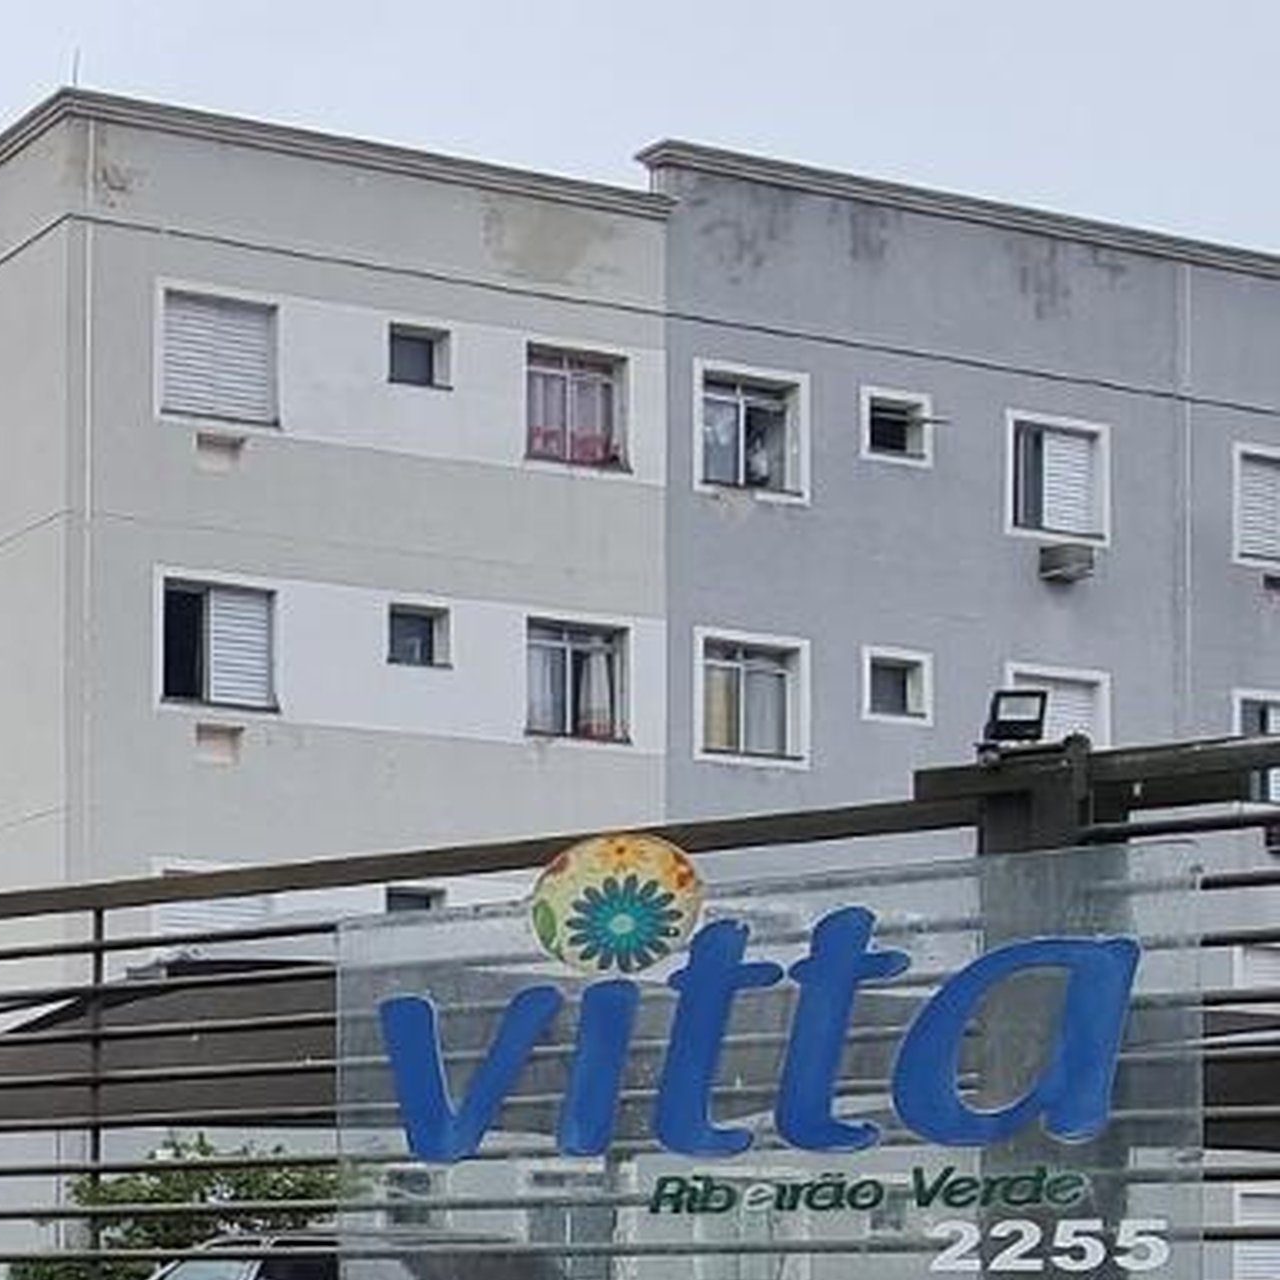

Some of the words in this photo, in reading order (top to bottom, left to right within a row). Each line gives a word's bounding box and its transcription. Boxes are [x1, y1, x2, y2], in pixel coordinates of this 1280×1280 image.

[378, 905, 1142, 1164] vitta
[912, 1164, 1088, 1208] Verde
[928, 1217, 1172, 1272] 2255
